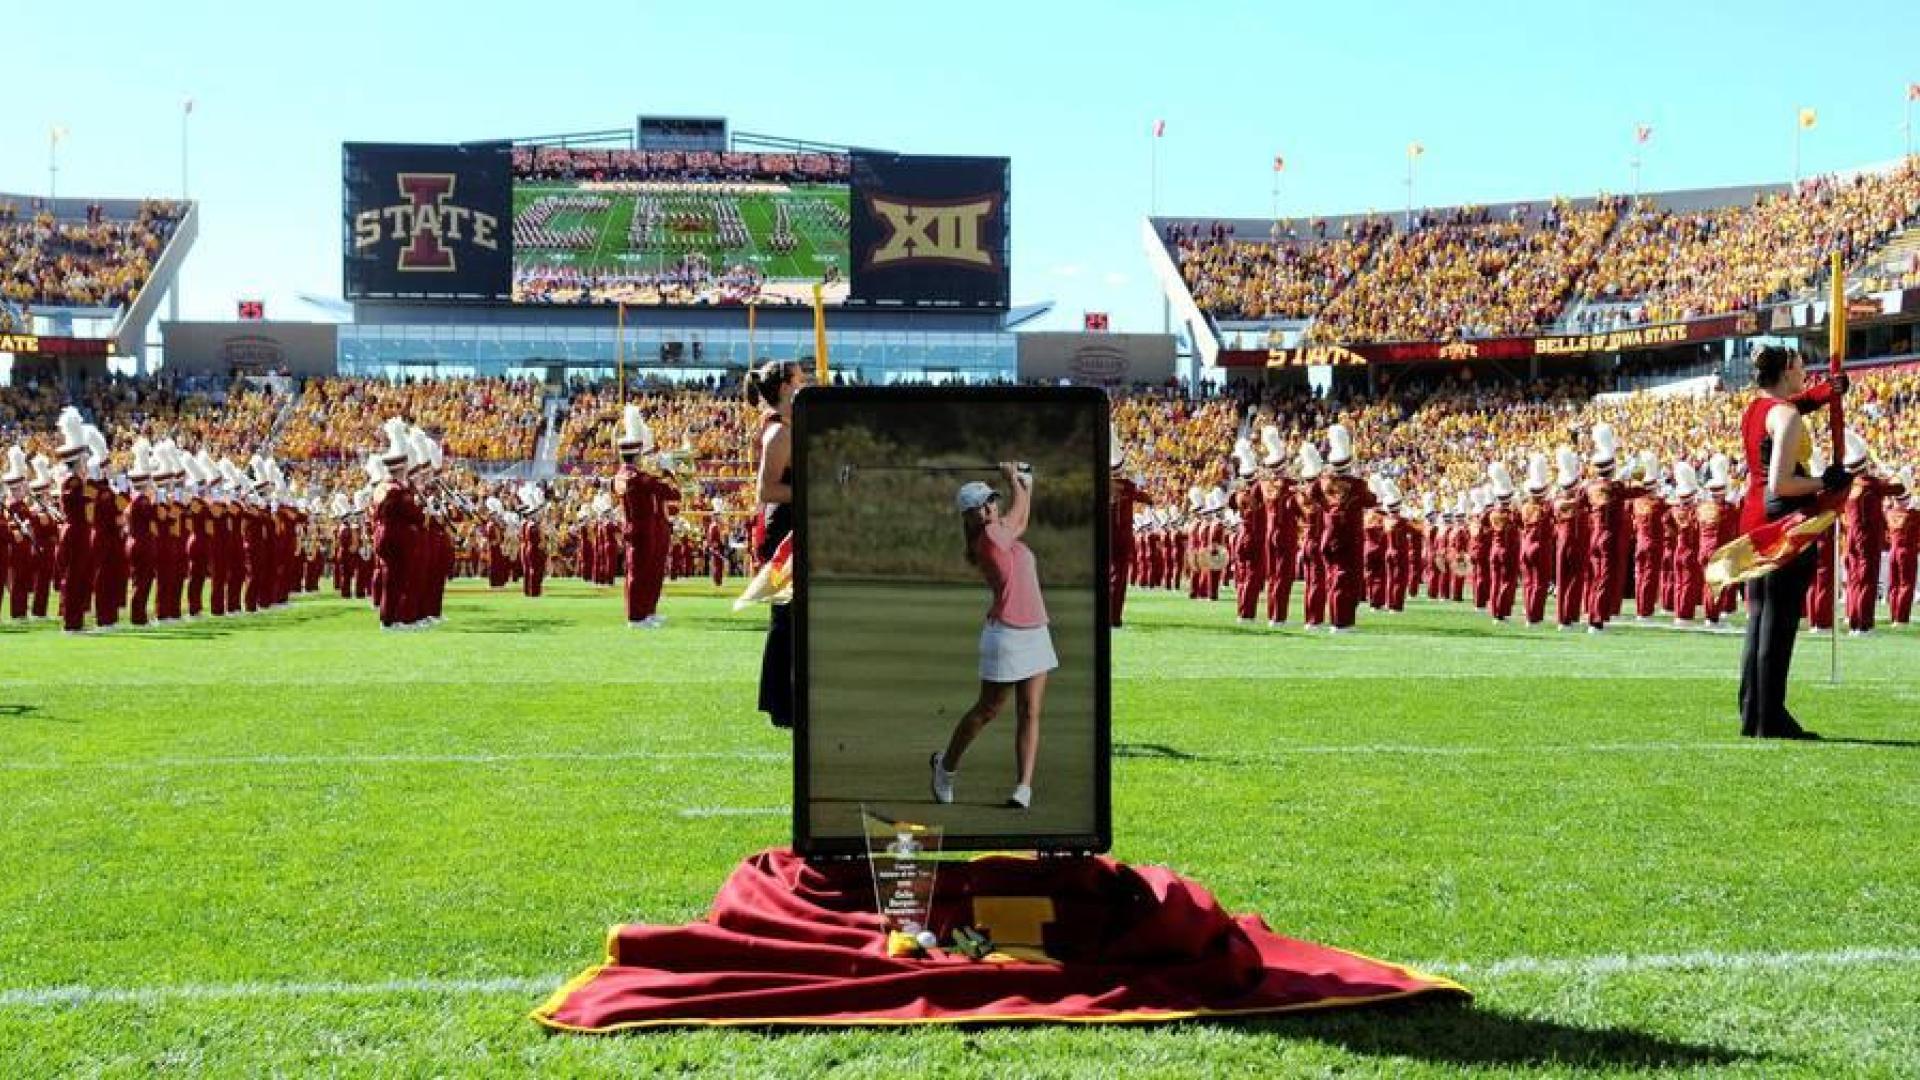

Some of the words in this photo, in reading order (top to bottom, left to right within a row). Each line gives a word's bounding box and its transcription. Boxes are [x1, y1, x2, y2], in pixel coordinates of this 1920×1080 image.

[355, 204, 498, 250] STATE
[872, 199, 993, 264] XII
[0, 335, 38, 352] ATE
[1536, 338, 1588, 353] BELLS
[1645, 324, 1688, 343] STATE
